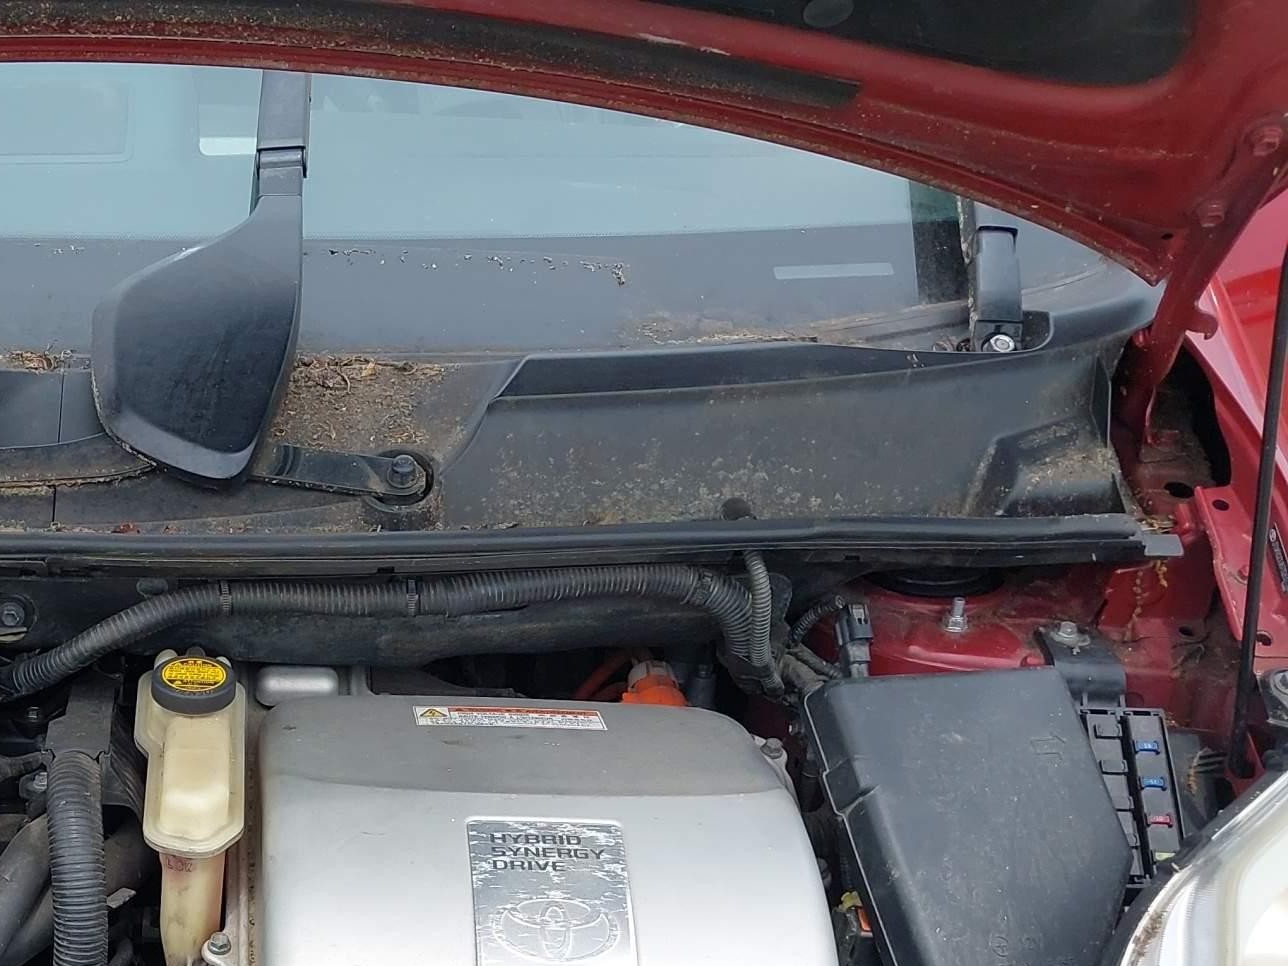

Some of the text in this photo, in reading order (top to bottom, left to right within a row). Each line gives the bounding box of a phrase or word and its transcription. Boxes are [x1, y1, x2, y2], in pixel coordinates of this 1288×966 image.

[489, 833, 582, 846] HYBRID
[490, 846, 606, 860] SYNERGY
[166, 857, 193, 873] LOW
[491, 859, 568, 872] DRIVE
